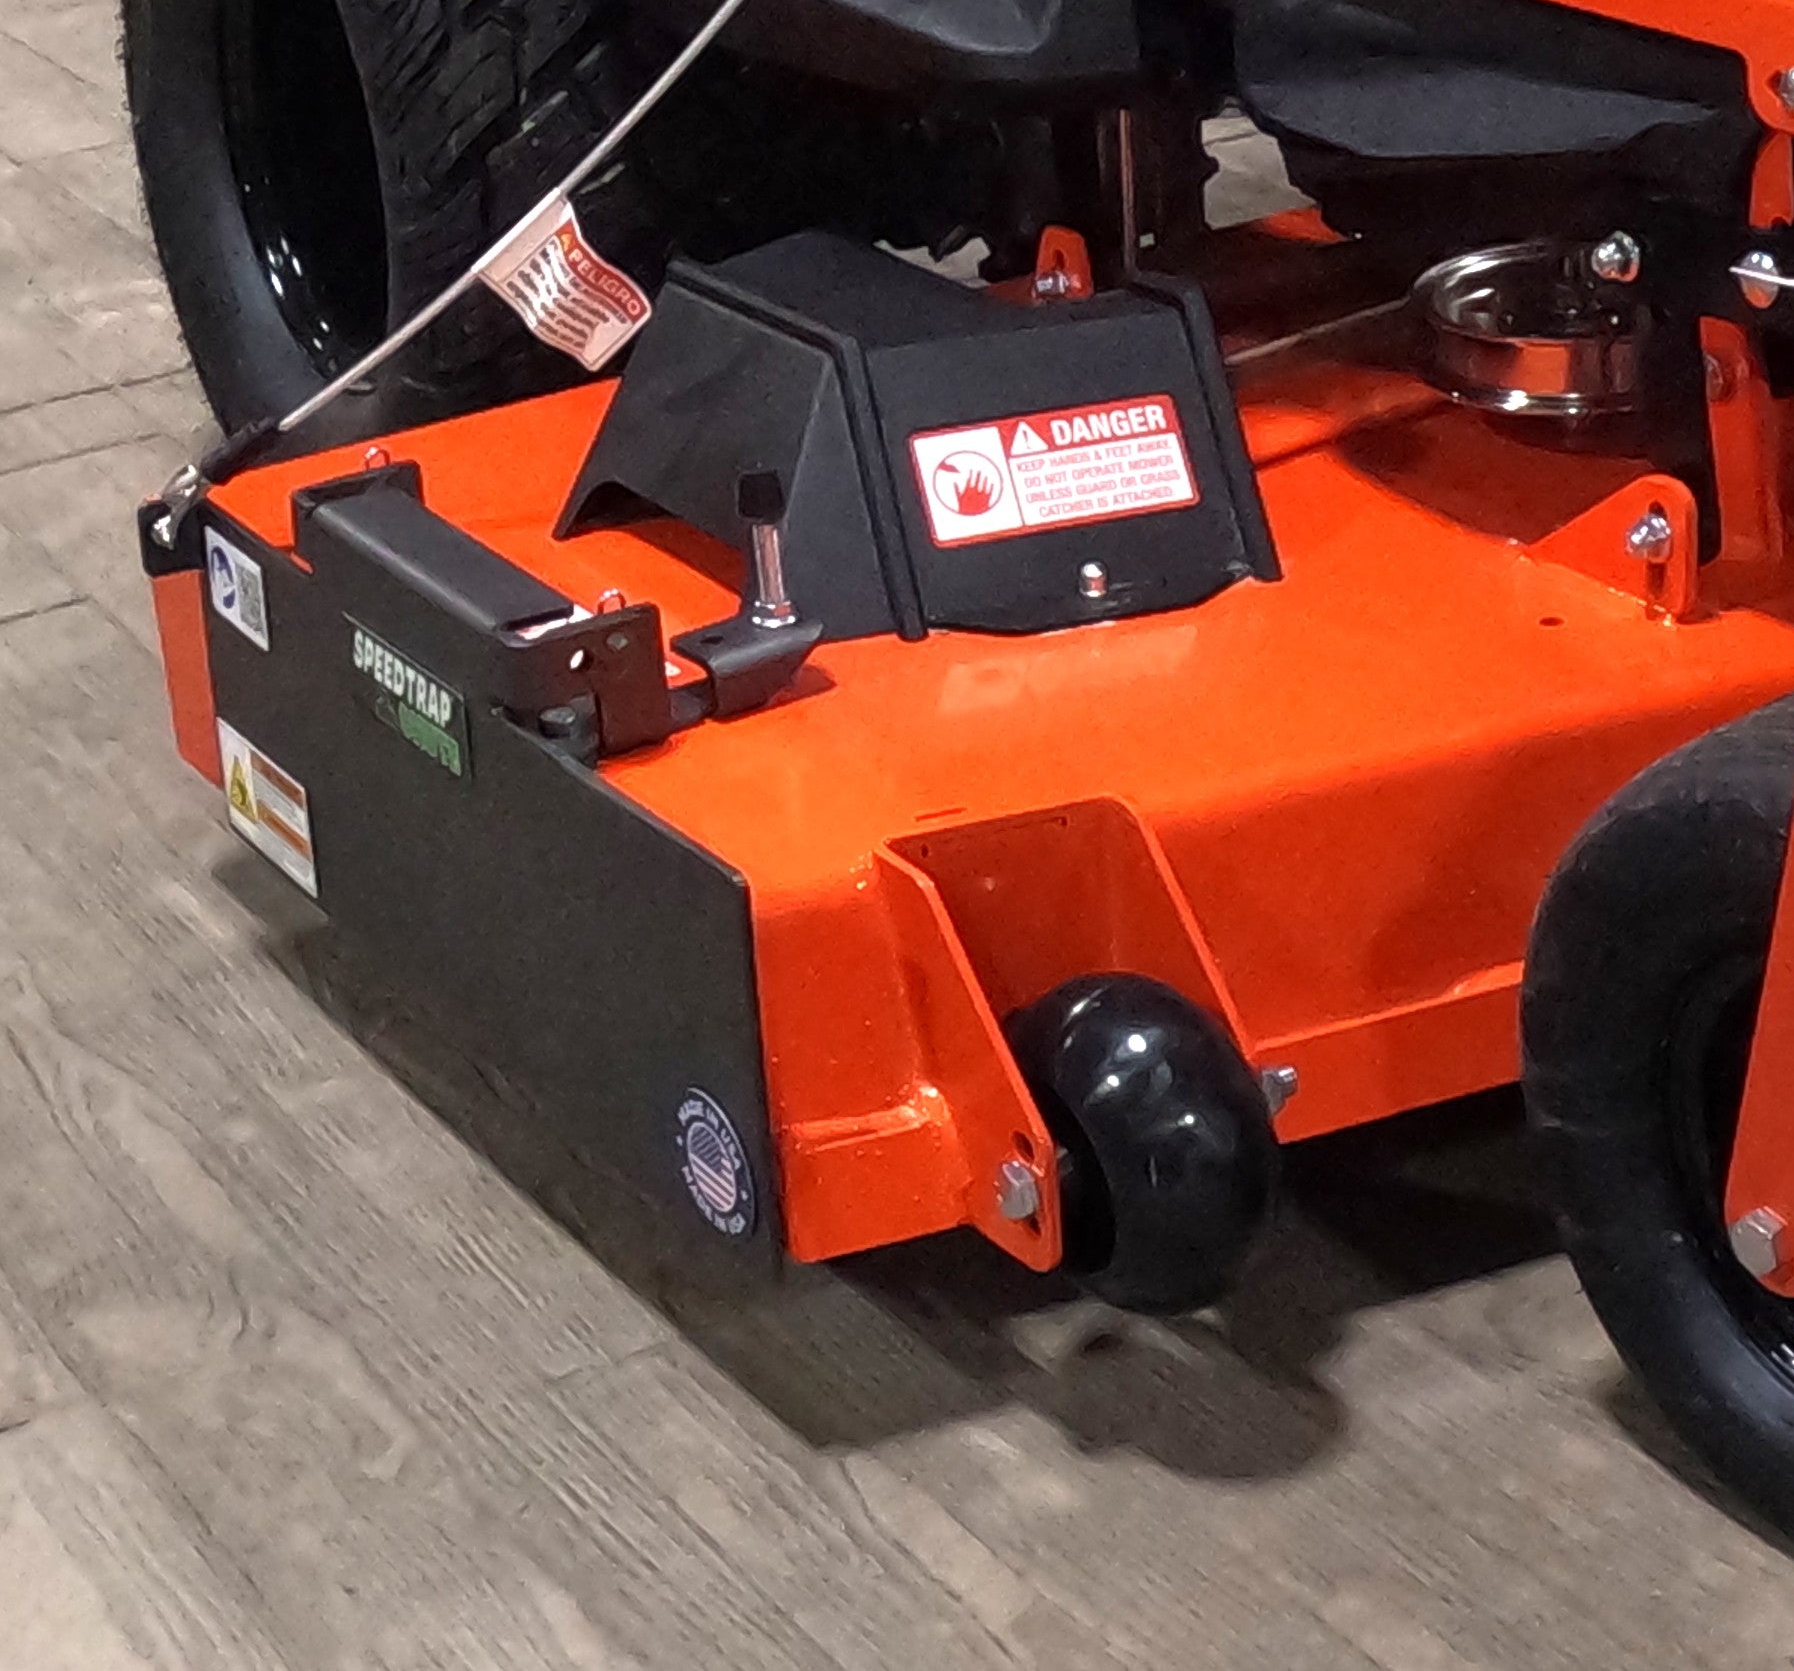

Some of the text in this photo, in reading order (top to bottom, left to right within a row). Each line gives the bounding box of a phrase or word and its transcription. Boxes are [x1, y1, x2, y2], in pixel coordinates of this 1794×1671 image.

[568, 247, 642, 317] PELIGRO
[1050, 404, 1167, 446] DANGER
[1016, 458, 1045, 473] KEEP
[1105, 444, 1132, 459] FEET
[1024, 454, 1174, 489] DO NOT OPERATE MOWER
[1026, 486, 1073, 504] UNLESS
[1076, 479, 1117, 496] GUARD
[1120, 476, 1138, 488] OR
[1039, 499, 1094, 518] CATCHER
[1097, 496, 1109, 508] IS
[353, 629, 452, 729] SPEEDTRAP
